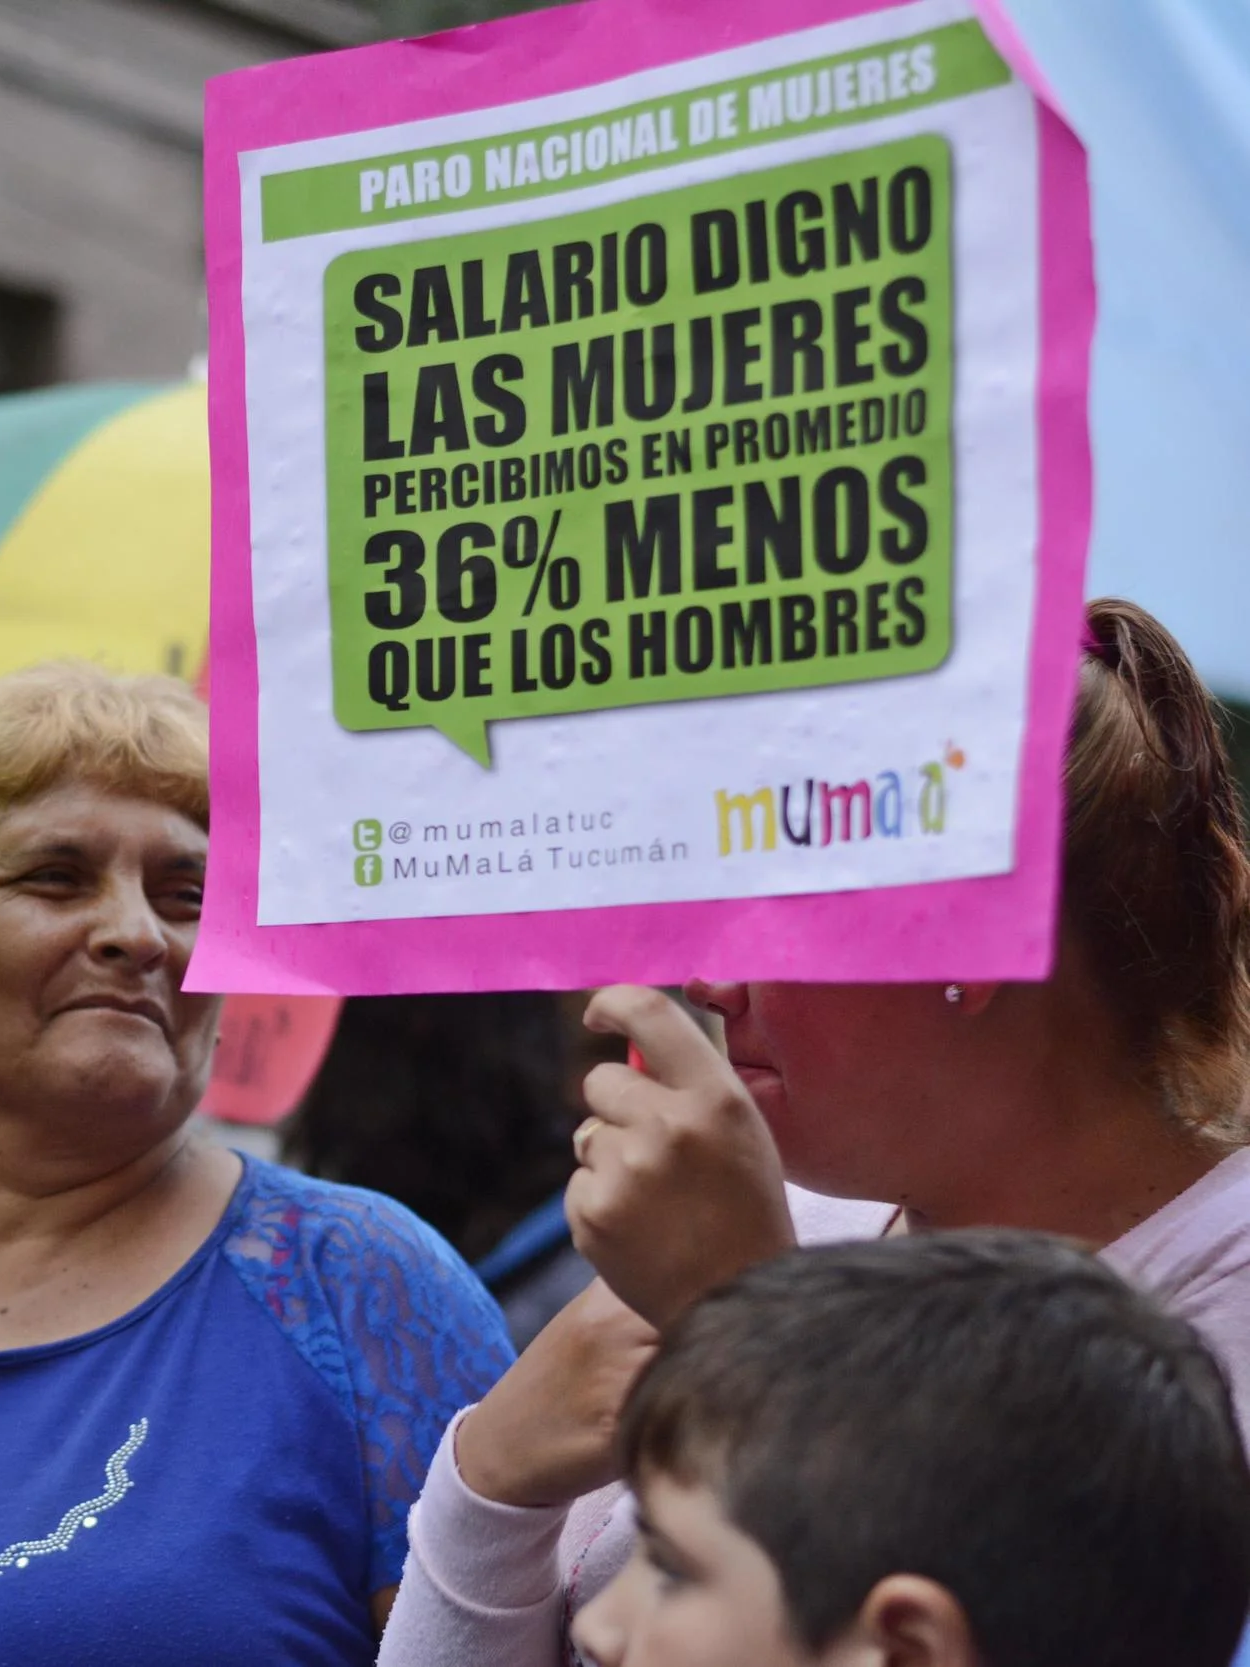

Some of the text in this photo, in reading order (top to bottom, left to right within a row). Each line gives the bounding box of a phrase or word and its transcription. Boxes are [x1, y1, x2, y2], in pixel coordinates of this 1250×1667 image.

[359, 43, 937, 213] PARO NACIONAL DE MUJERES
[353, 165, 933, 353] SALARIO DIGNO
[362, 275, 930, 463] LAS MUJERES
[363, 388, 928, 517] PERCIBIMOS EN PROMEDIO
[363, 455, 930, 631] 36% MENOS
[368, 576, 927, 712] QUE LOS HOMBRES
[393, 849, 534, 880] MuMaLá
[547, 837, 690, 870] Tucumán
